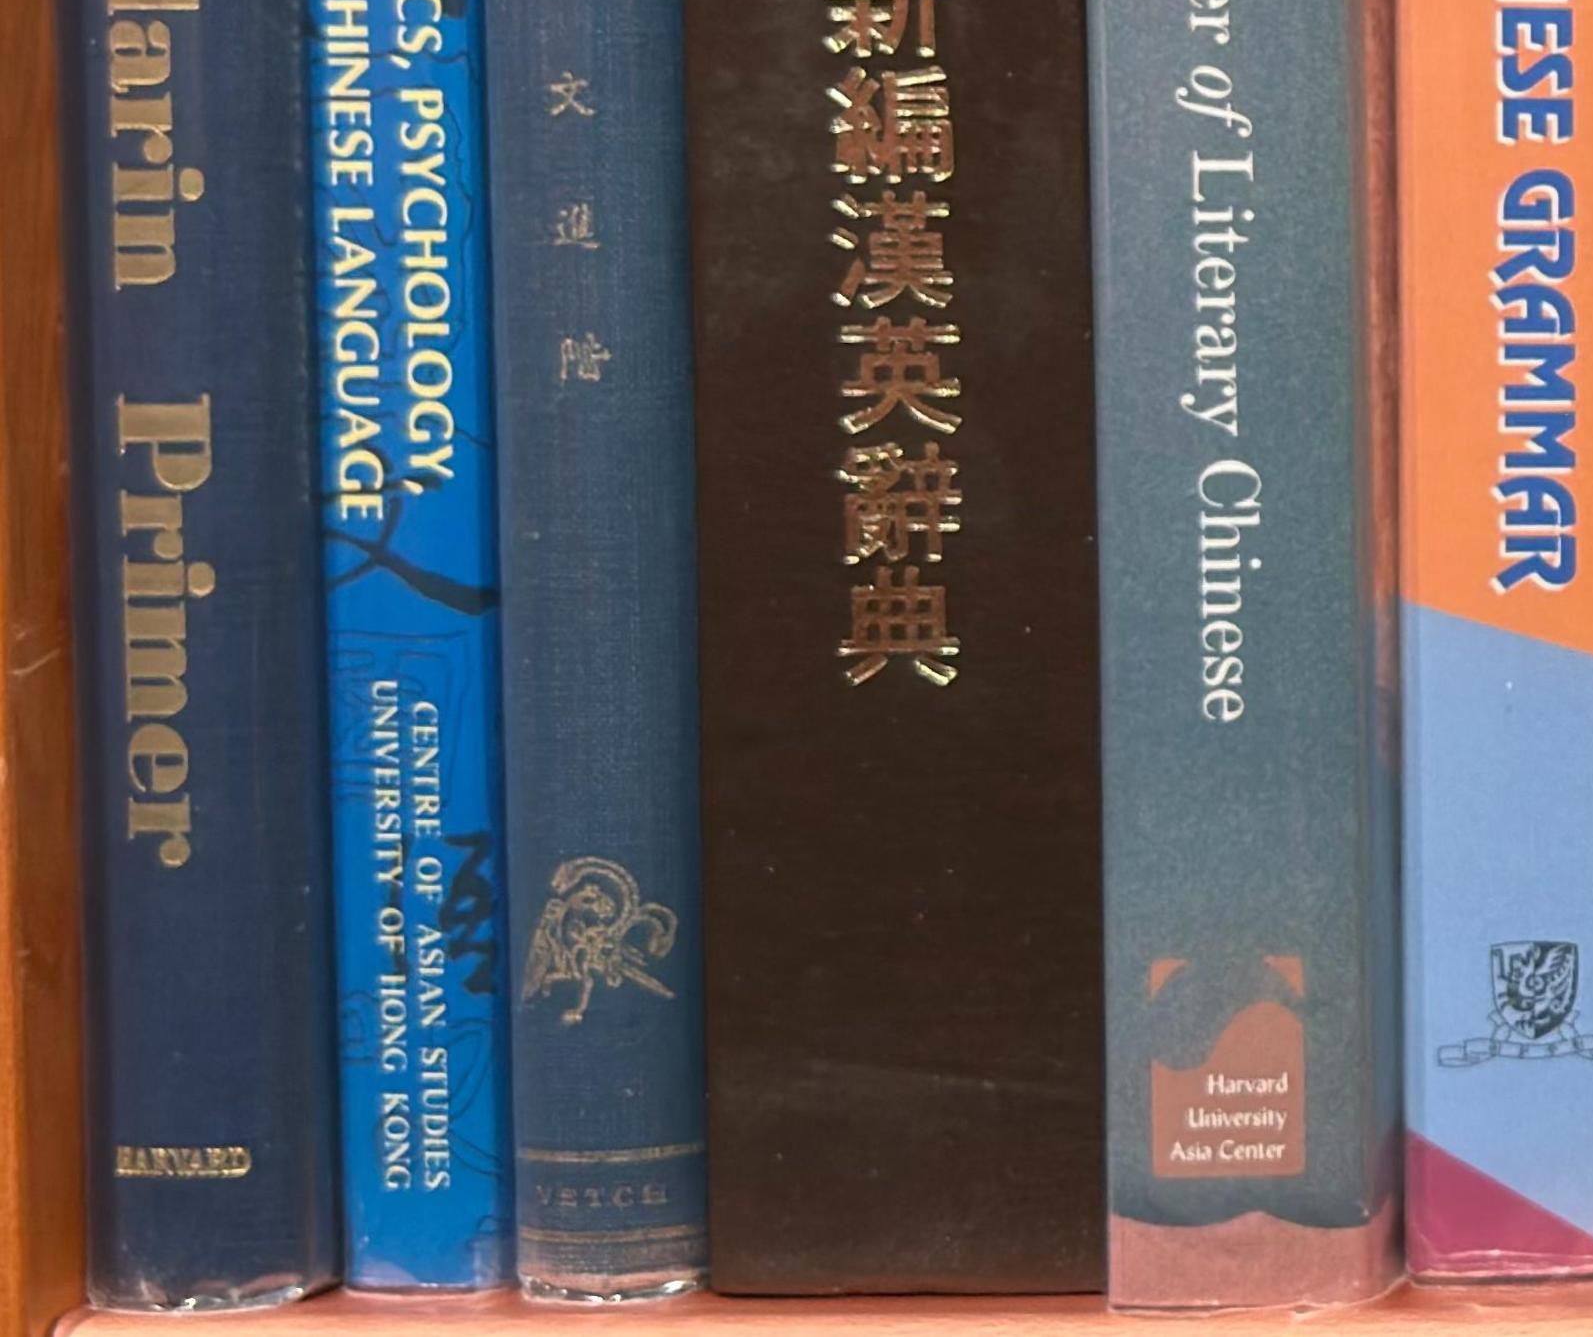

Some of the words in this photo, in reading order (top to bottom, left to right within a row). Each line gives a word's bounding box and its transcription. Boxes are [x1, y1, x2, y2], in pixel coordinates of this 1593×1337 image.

[1174, 64, 1253, 141] of
[399, 88, 455, 497] PSYCHOLOGY,
[1179, 150, 1255, 439] Literary
[329, 205, 387, 522] LANGUAGE
[1488, 166, 1580, 597] GRAMMAR
[117, 393, 216, 869] Primer
[1197, 459, 1263, 724] Chinese
[369, 680, 405, 887] UNIVERSITY
[410, 700, 442, 840] CENTRE
[377, 905, 407, 957] OF
[415, 854, 443, 907] OF
[379, 973, 409, 1073] HONG
[417, 924, 447, 1028] ASIAN
[382, 1092, 412, 1190] KONG
[417, 1046, 450, 1190] STUDIES
[1187, 1104, 1288, 1133] University
[1206, 1072, 1289, 1095] Harvard
[1170, 1140, 1212, 1162] Asia
[1218, 1138, 1286, 1161] Center
